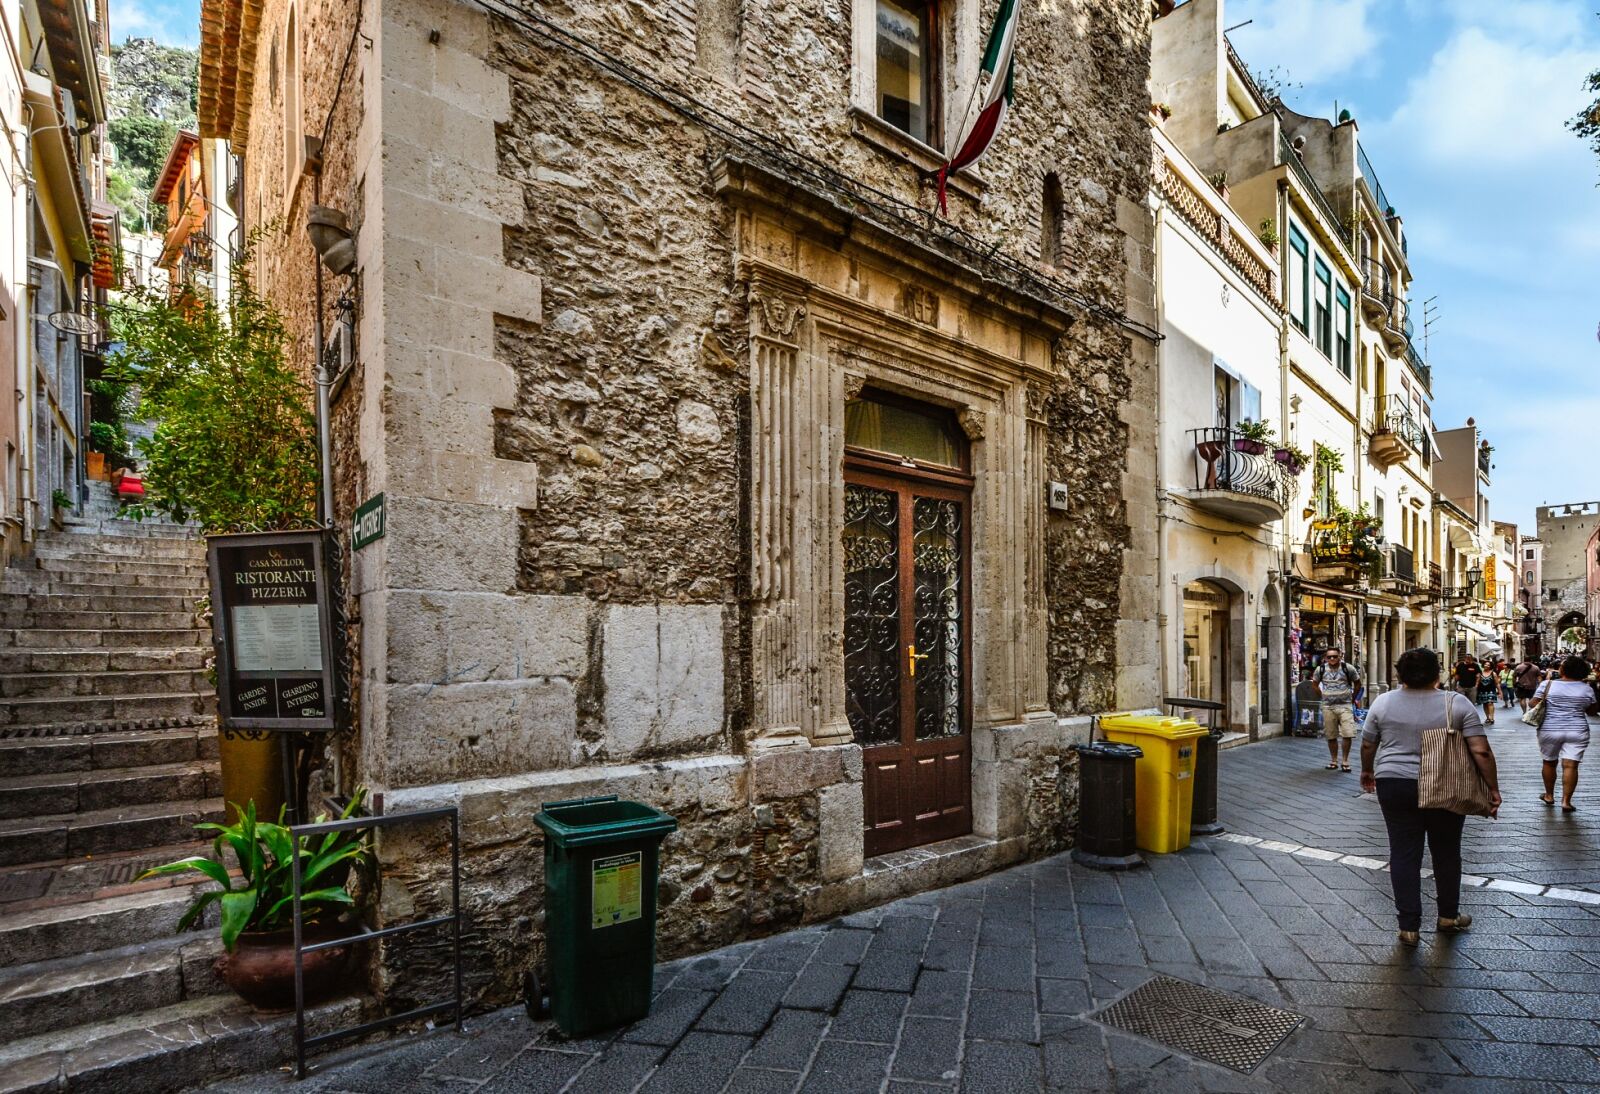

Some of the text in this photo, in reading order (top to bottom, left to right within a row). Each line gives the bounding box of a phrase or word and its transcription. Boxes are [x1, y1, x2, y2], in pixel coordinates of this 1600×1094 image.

[360, 505, 382, 541] INTERNET
[249, 560, 270, 568] CASA
[1487, 559, 1495, 596] Kodak
[252, 587, 307, 598] PIZZERIA
[238, 686, 267, 701] GARDEN
[282, 681, 318, 699] GIARDINO
[244, 697, 268, 711] INSIDE
[286, 692, 319, 708] INTERNO
